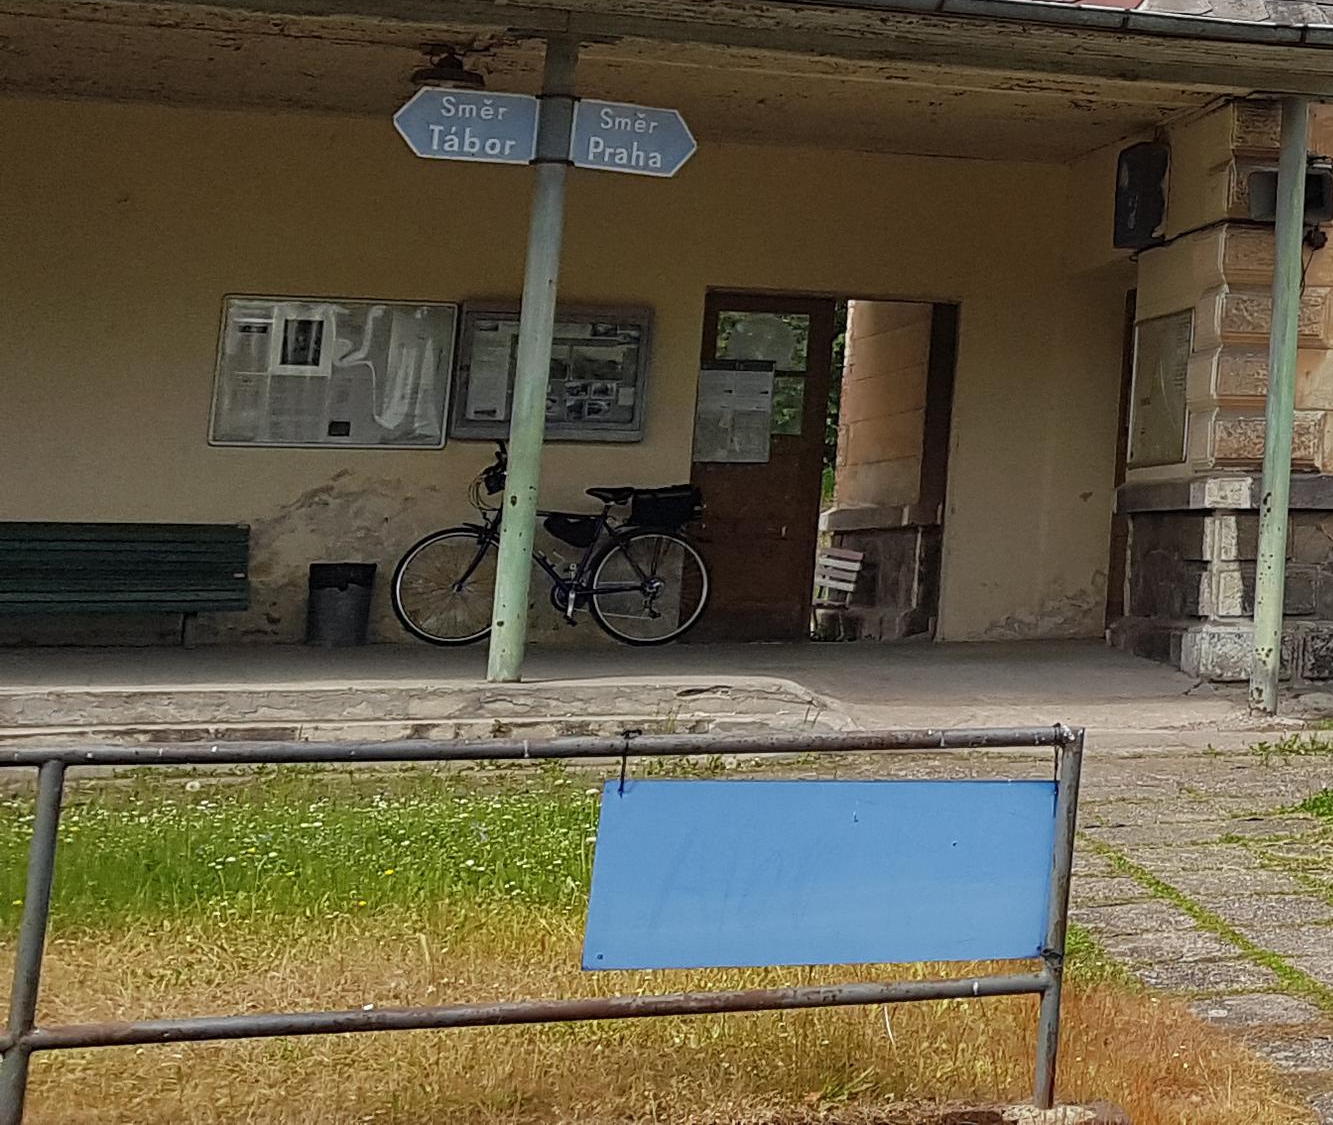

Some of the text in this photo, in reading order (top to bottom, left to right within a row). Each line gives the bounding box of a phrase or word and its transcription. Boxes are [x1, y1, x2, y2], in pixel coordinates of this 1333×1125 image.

[440, 95, 508, 120] Směr
[600, 108, 659, 134] Směr
[428, 124, 517, 156] Tábor
[587, 136, 663, 169] Praha
